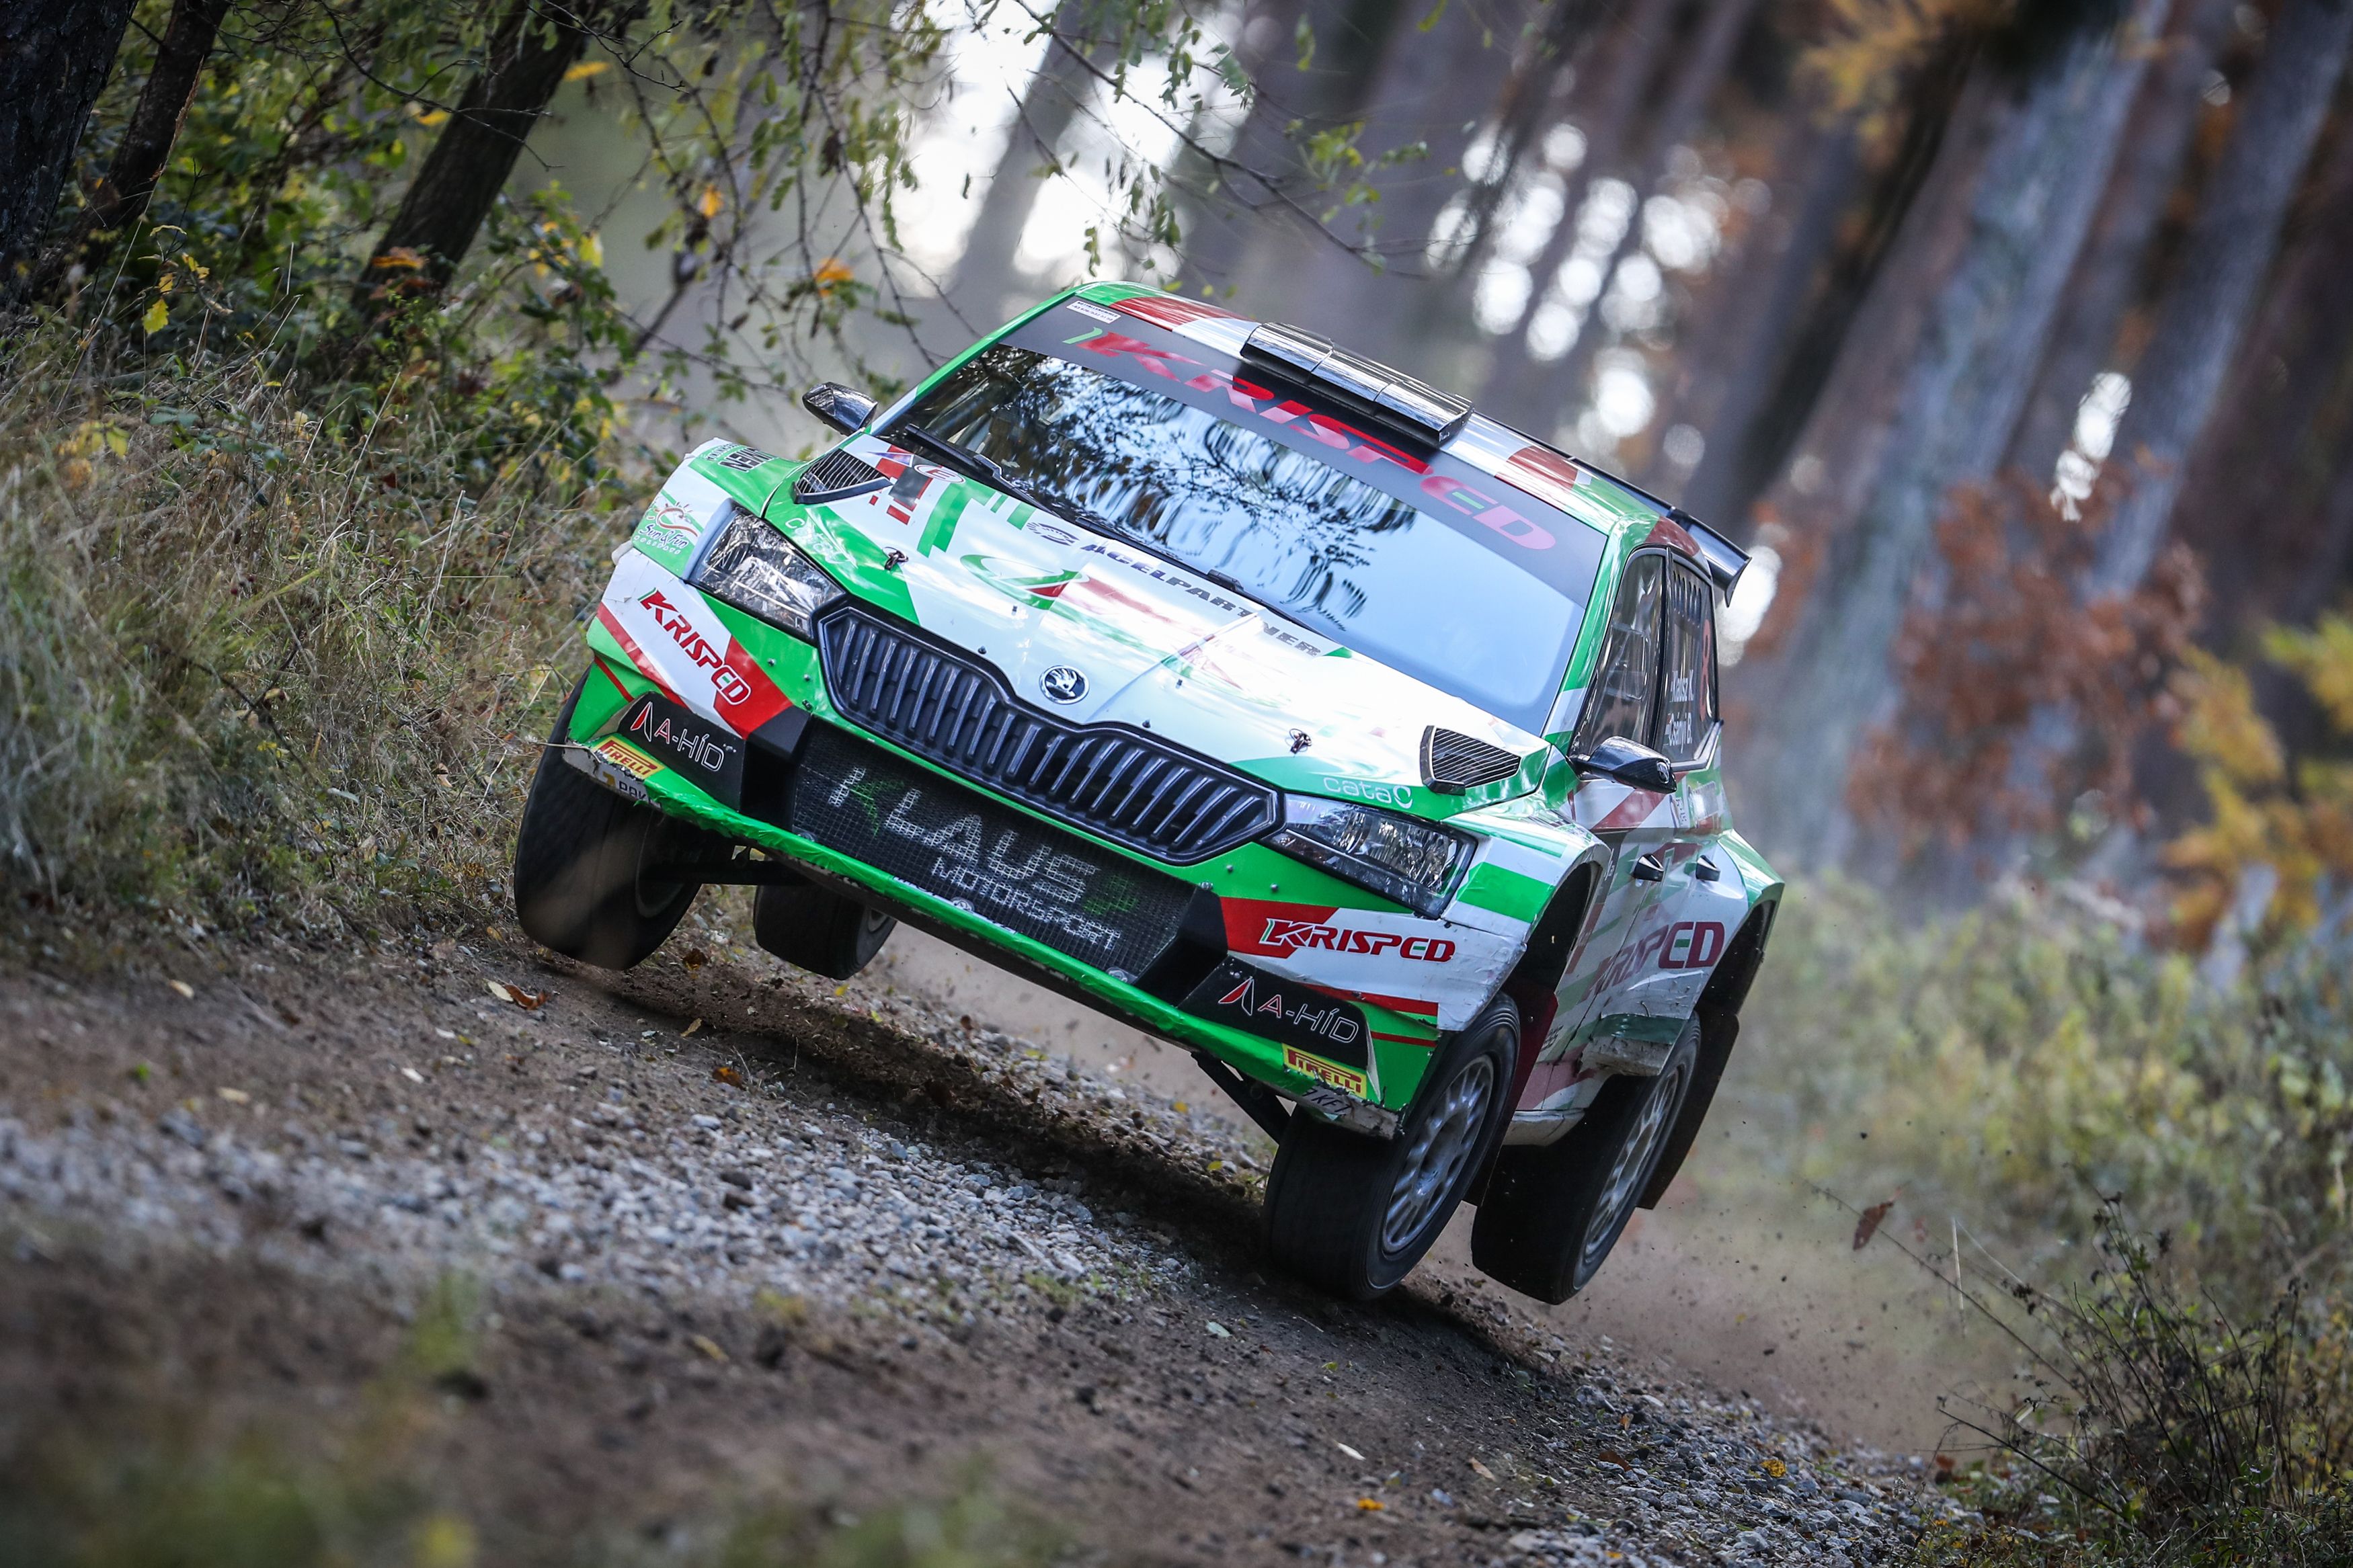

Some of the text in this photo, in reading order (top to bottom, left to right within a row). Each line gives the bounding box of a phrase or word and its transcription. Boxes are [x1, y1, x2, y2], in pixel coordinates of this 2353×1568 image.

[1062, 327, 1556, 550] KRISPED
[637, 587, 752, 706] KRISPED
[599, 739, 658, 775] PIRELLI
[653, 717, 725, 772] A-HÍD
[828, 766, 1101, 904] KLAUS
[931, 857, 1122, 951] MOTORSPORT
[1259, 917, 1456, 962] KRISPED
[1258, 994, 1359, 1044] A-HÍD
[1287, 1048, 1362, 1094] PIRELLI
